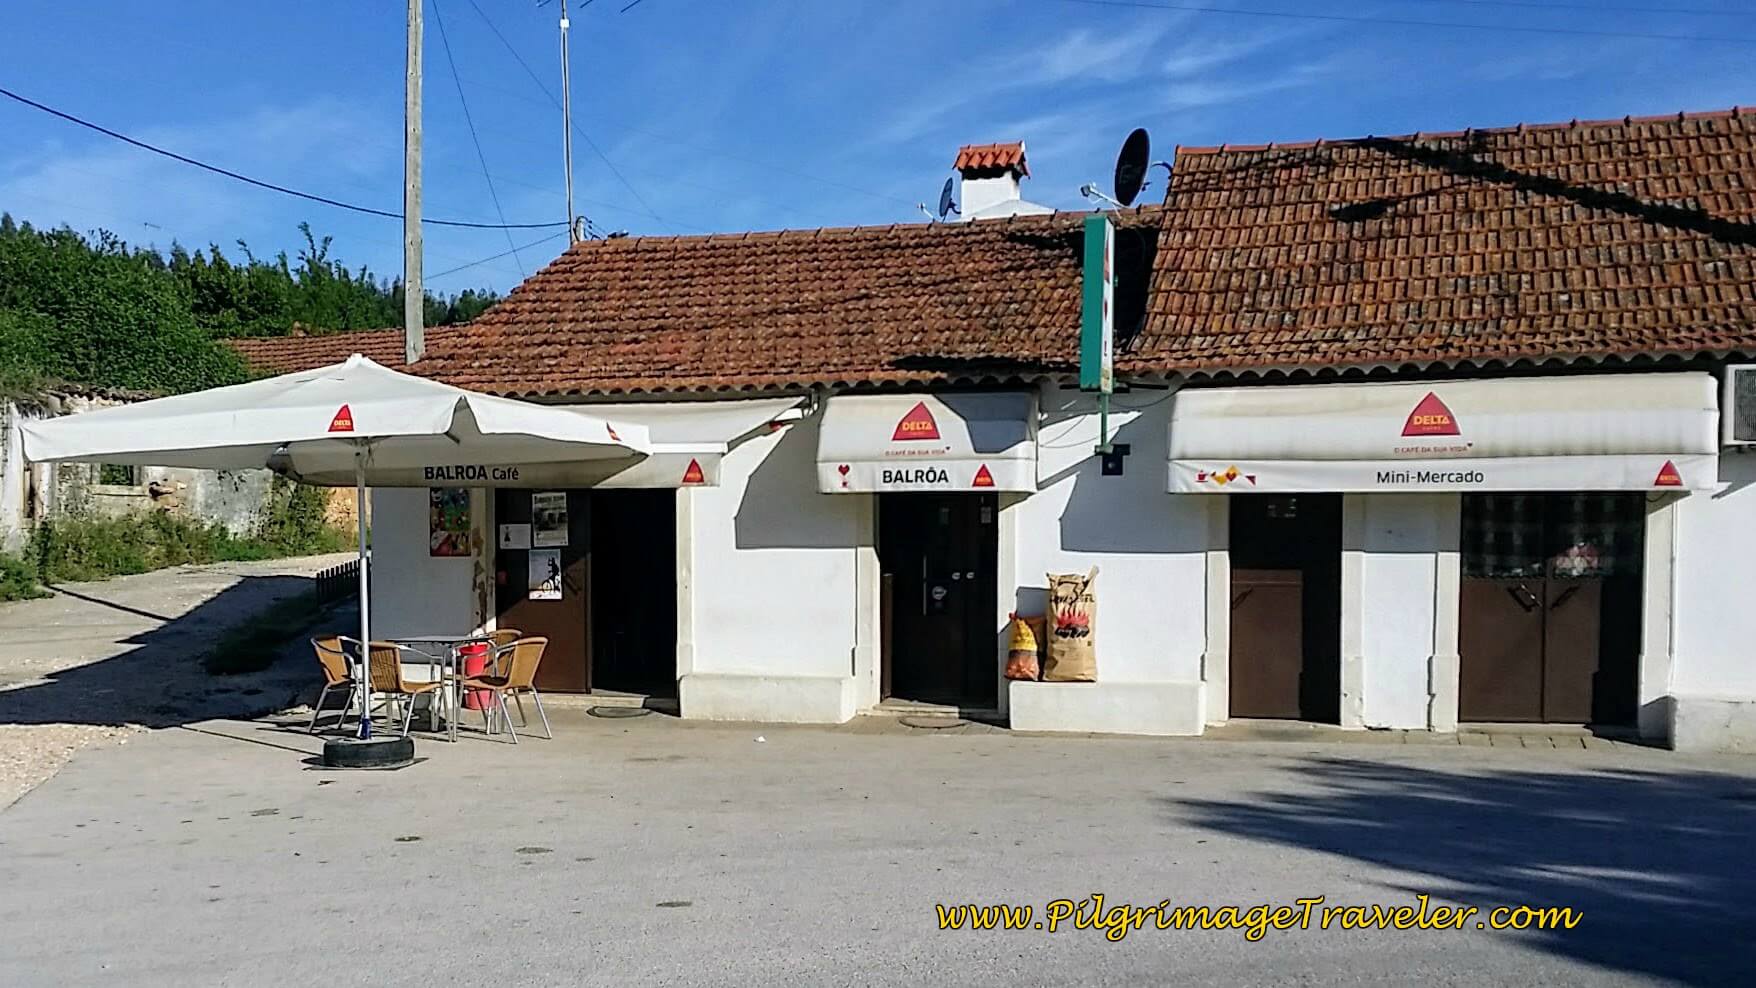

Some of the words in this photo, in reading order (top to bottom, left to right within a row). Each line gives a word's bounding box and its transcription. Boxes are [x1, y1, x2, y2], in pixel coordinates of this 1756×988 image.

[1413, 415, 1450, 425] DELTA
[902, 421, 933, 432] DELTA
[424, 465, 488, 480] BALROA
[492, 466, 520, 480] Café
[1377, 470, 1484, 483] Mini-Mercado
